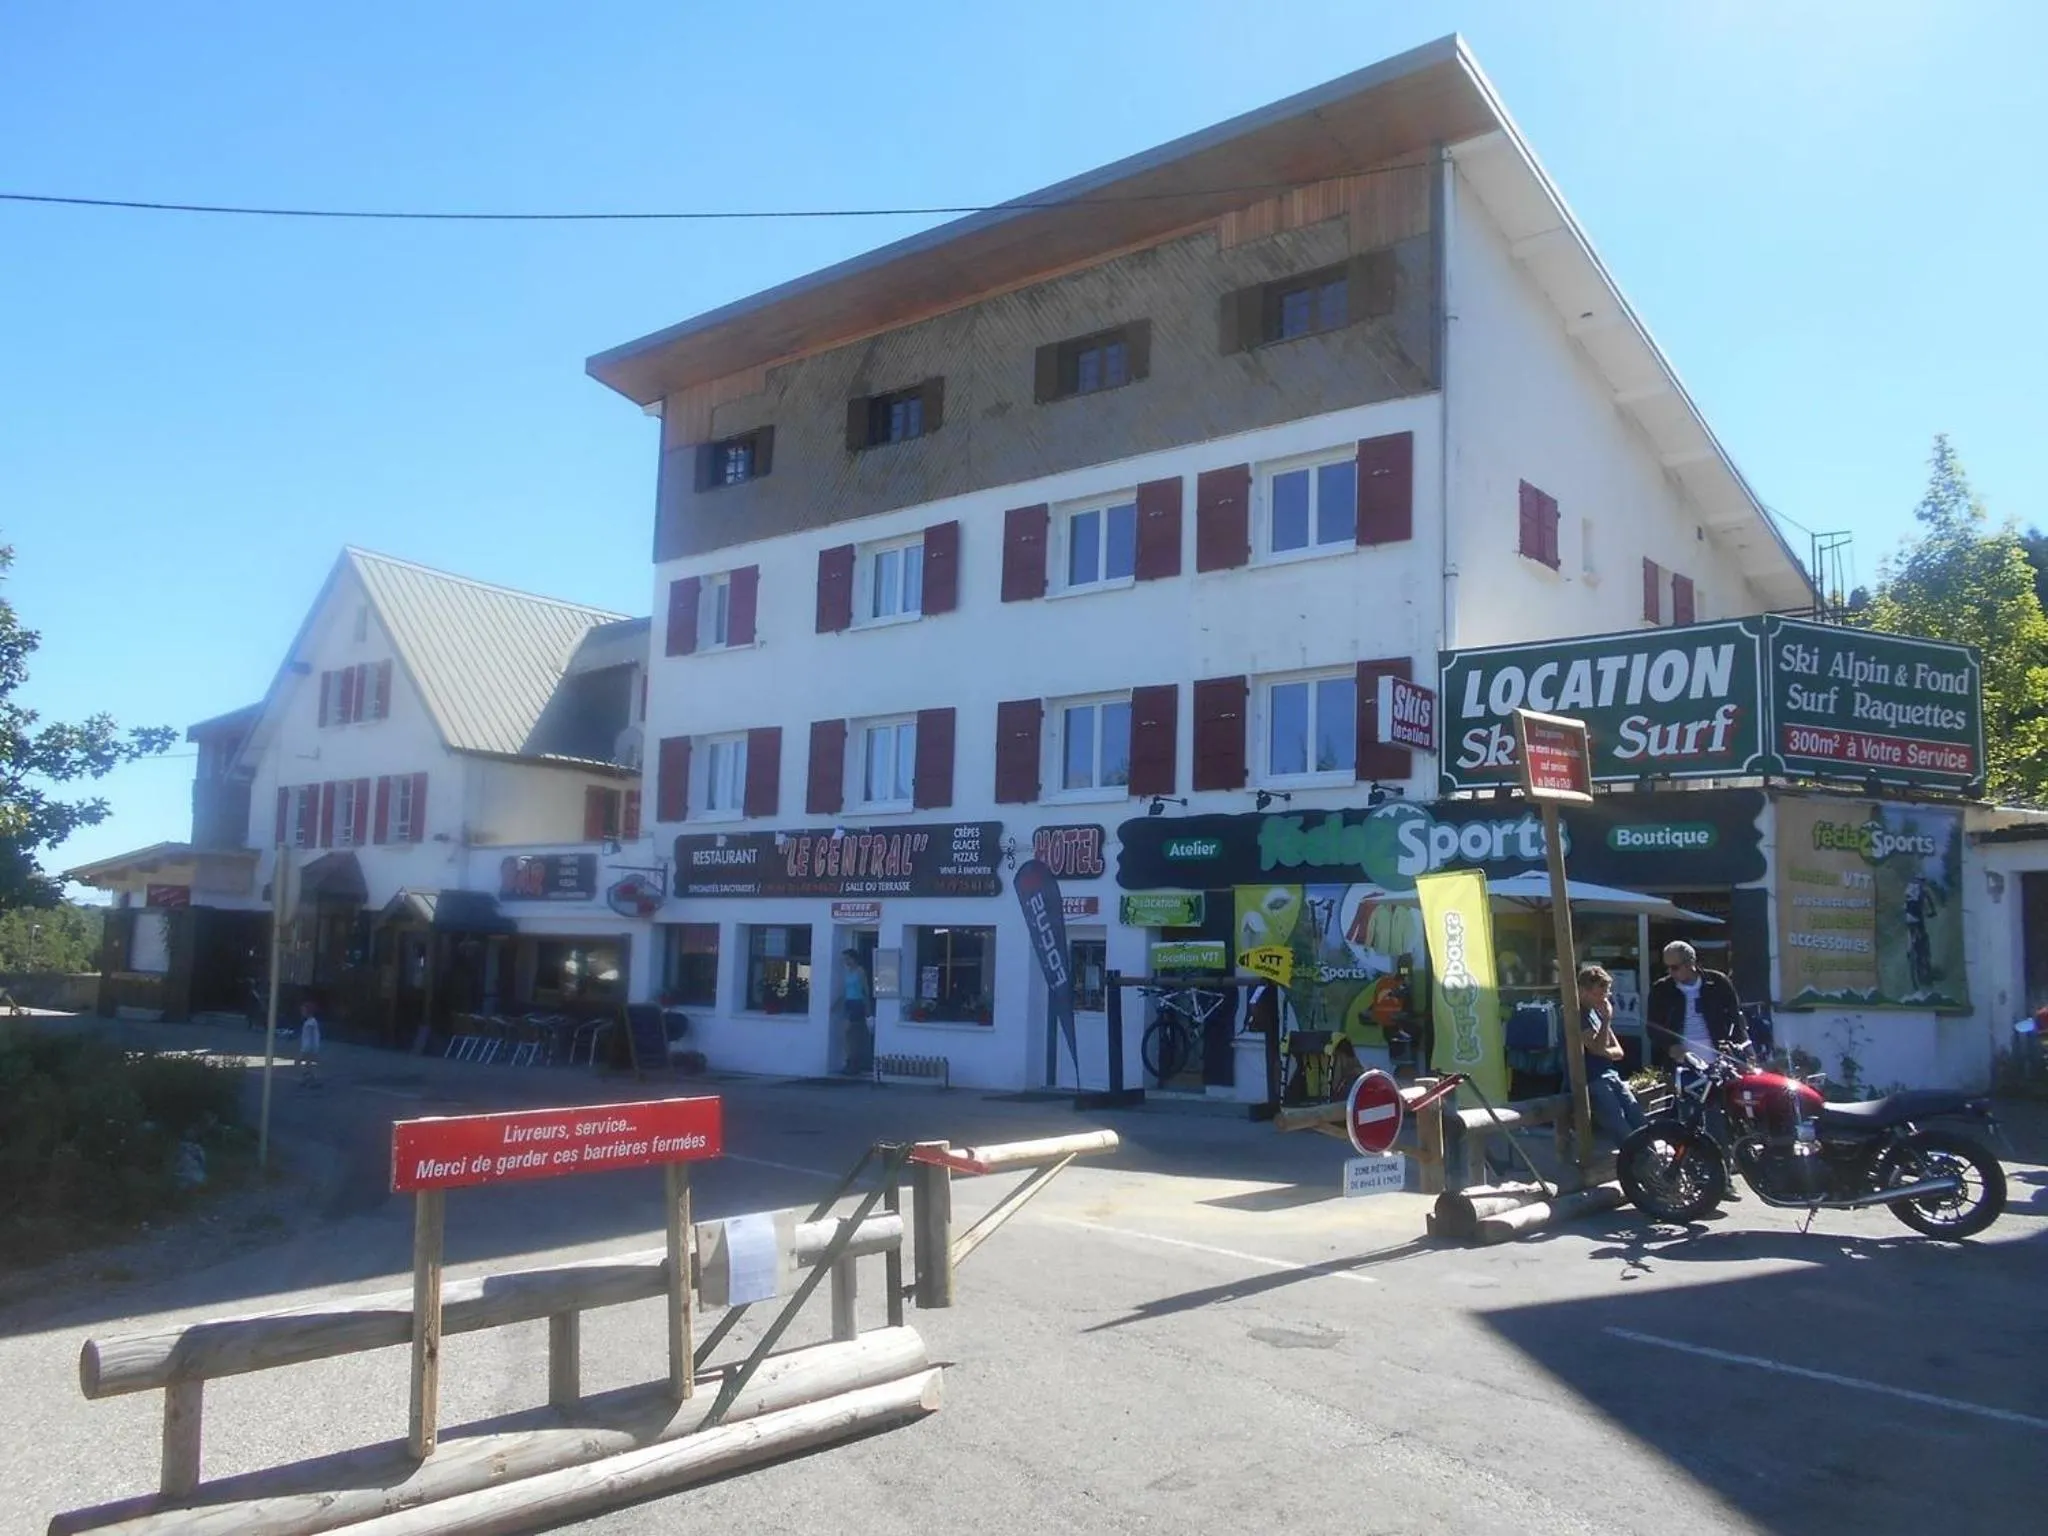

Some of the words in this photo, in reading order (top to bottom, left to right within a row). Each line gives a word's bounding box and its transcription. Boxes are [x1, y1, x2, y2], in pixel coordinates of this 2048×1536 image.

[1780, 643, 1820, 675] Ski
[1828, 651, 1890, 688] Alpin
[1894, 663, 1909, 687] &
[1914, 663, 1970, 696] Fond
[1461, 644, 1736, 718] LOCATION
[1393, 684, 1432, 728] Skis
[1786, 683, 1840, 714] Surf
[1852, 691, 1967, 730] Raquettes
[1393, 720, 1432, 747] location
[1456, 724, 1520, 769] Sk
[1613, 704, 1737, 760] Surf
[1847, 735, 1857, 757] à
[1861, 738, 1902, 762] Votre
[1906, 744, 1968, 769] Service
[953, 825, 981, 838] CRÊPES
[1616, 827, 1710, 848] Boutique
[952, 839, 981, 851] GLACES
[1169, 840, 1217, 857] Atelier
[692, 849, 758, 865] RESTAURANT
[953, 852, 979, 863] PIZZAS
[878, 881, 911, 891] TERRASSE
[1843, 870, 1872, 889] VTT
[1157, 951, 1198, 962] Location
[1201, 951, 1220, 962] VTT
[1259, 954, 1283, 967] VTT
[503, 1125, 570, 1143] Livreurs,
[416, 1157, 467, 1179] Merci
[471, 1155, 491, 1173] de
[496, 1150, 548, 1175] garder
[553, 1150, 578, 1164] ces
[583, 1140, 648, 1161] barrières
[652, 1133, 706, 1153] fermées
